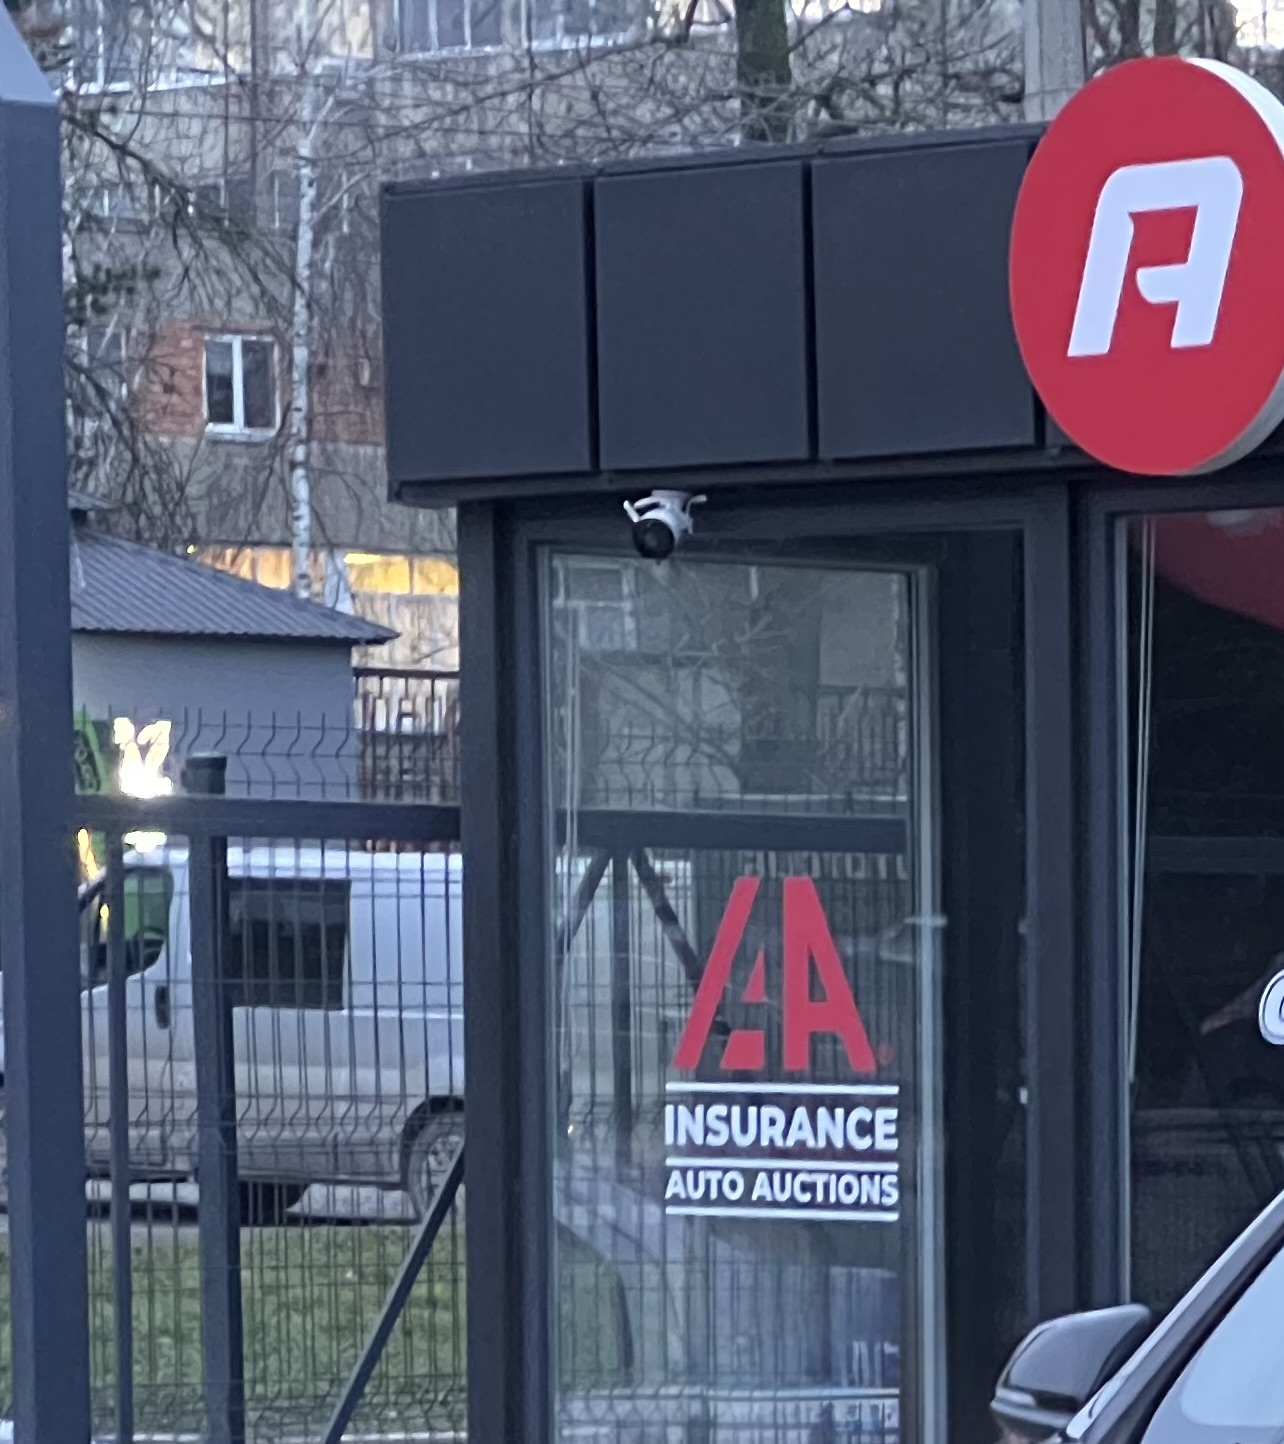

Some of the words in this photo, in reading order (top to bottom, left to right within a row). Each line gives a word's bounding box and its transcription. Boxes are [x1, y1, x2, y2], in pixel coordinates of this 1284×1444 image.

[1066, 155, 1244, 359] A
[664, 1103, 899, 1151] INSURANCE
[665, 1169, 745, 1201] AUTO
[751, 1171, 899, 1207] AUCTIONS
